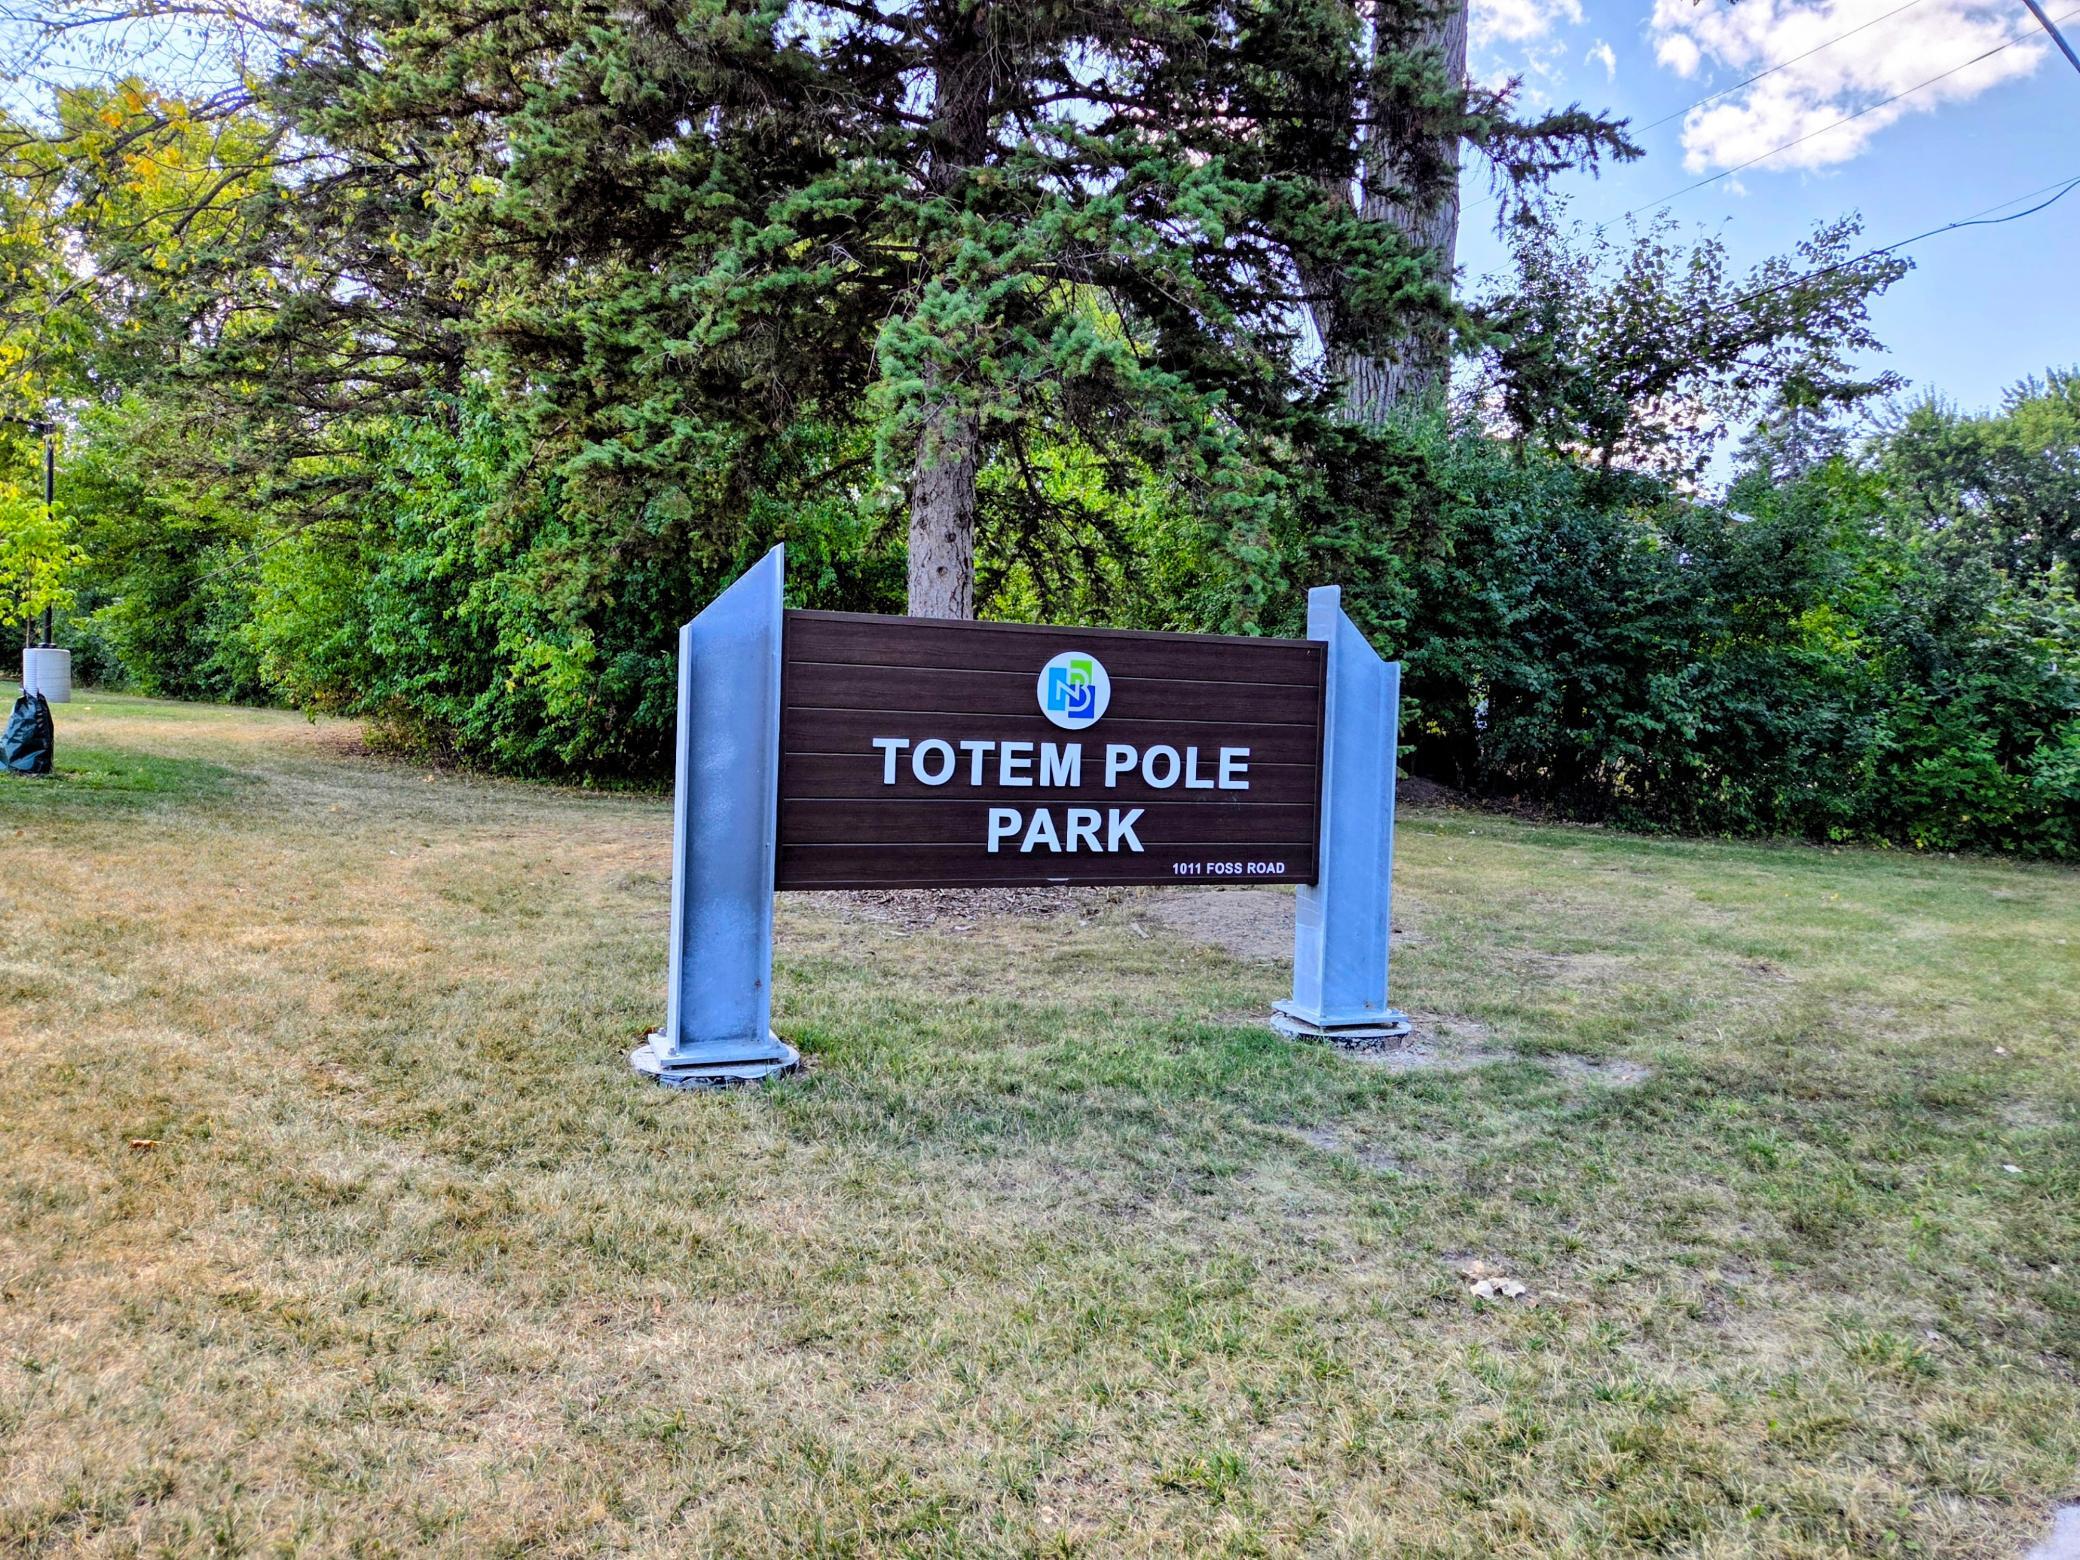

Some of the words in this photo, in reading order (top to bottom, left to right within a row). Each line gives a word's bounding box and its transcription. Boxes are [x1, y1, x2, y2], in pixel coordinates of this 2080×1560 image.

[872, 737, 1082, 787] TOTEM
[1104, 743, 1250, 790] POLE
[987, 807, 1145, 853] PARK
[1172, 862, 1201, 875] 1011
[1206, 862, 1243, 875] FOSS
[1247, 862, 1285, 874] ROAD
